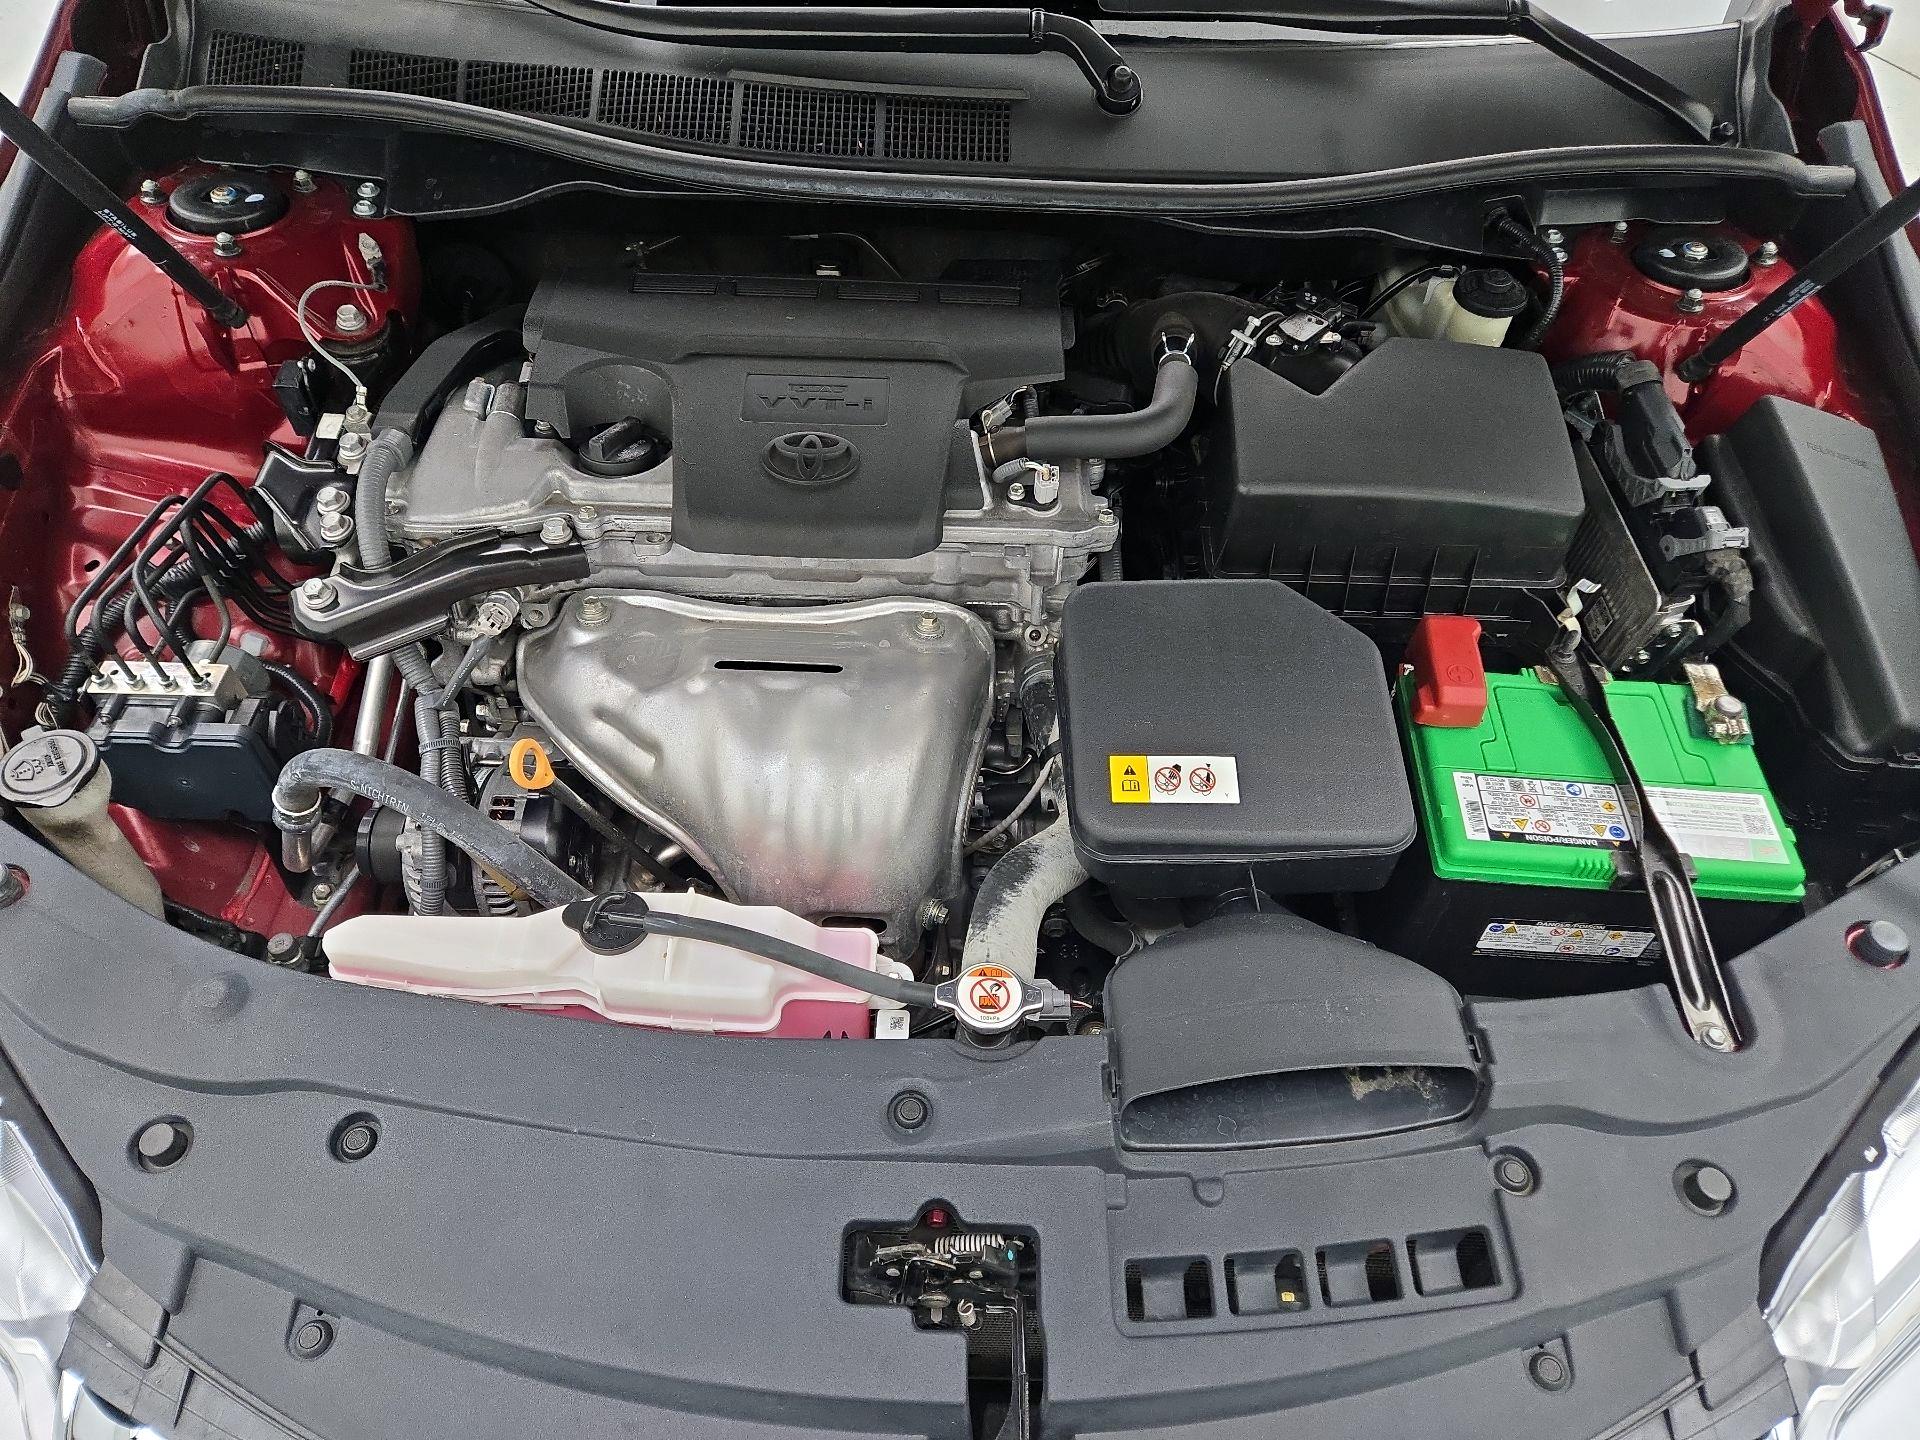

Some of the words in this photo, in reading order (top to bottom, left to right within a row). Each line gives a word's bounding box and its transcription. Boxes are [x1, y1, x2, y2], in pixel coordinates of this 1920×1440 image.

[103, 208, 138, 237] STABILUS
[757, 395, 873, 411] VVT-i
[1525, 835, 1598, 846] DANGER/POISON
